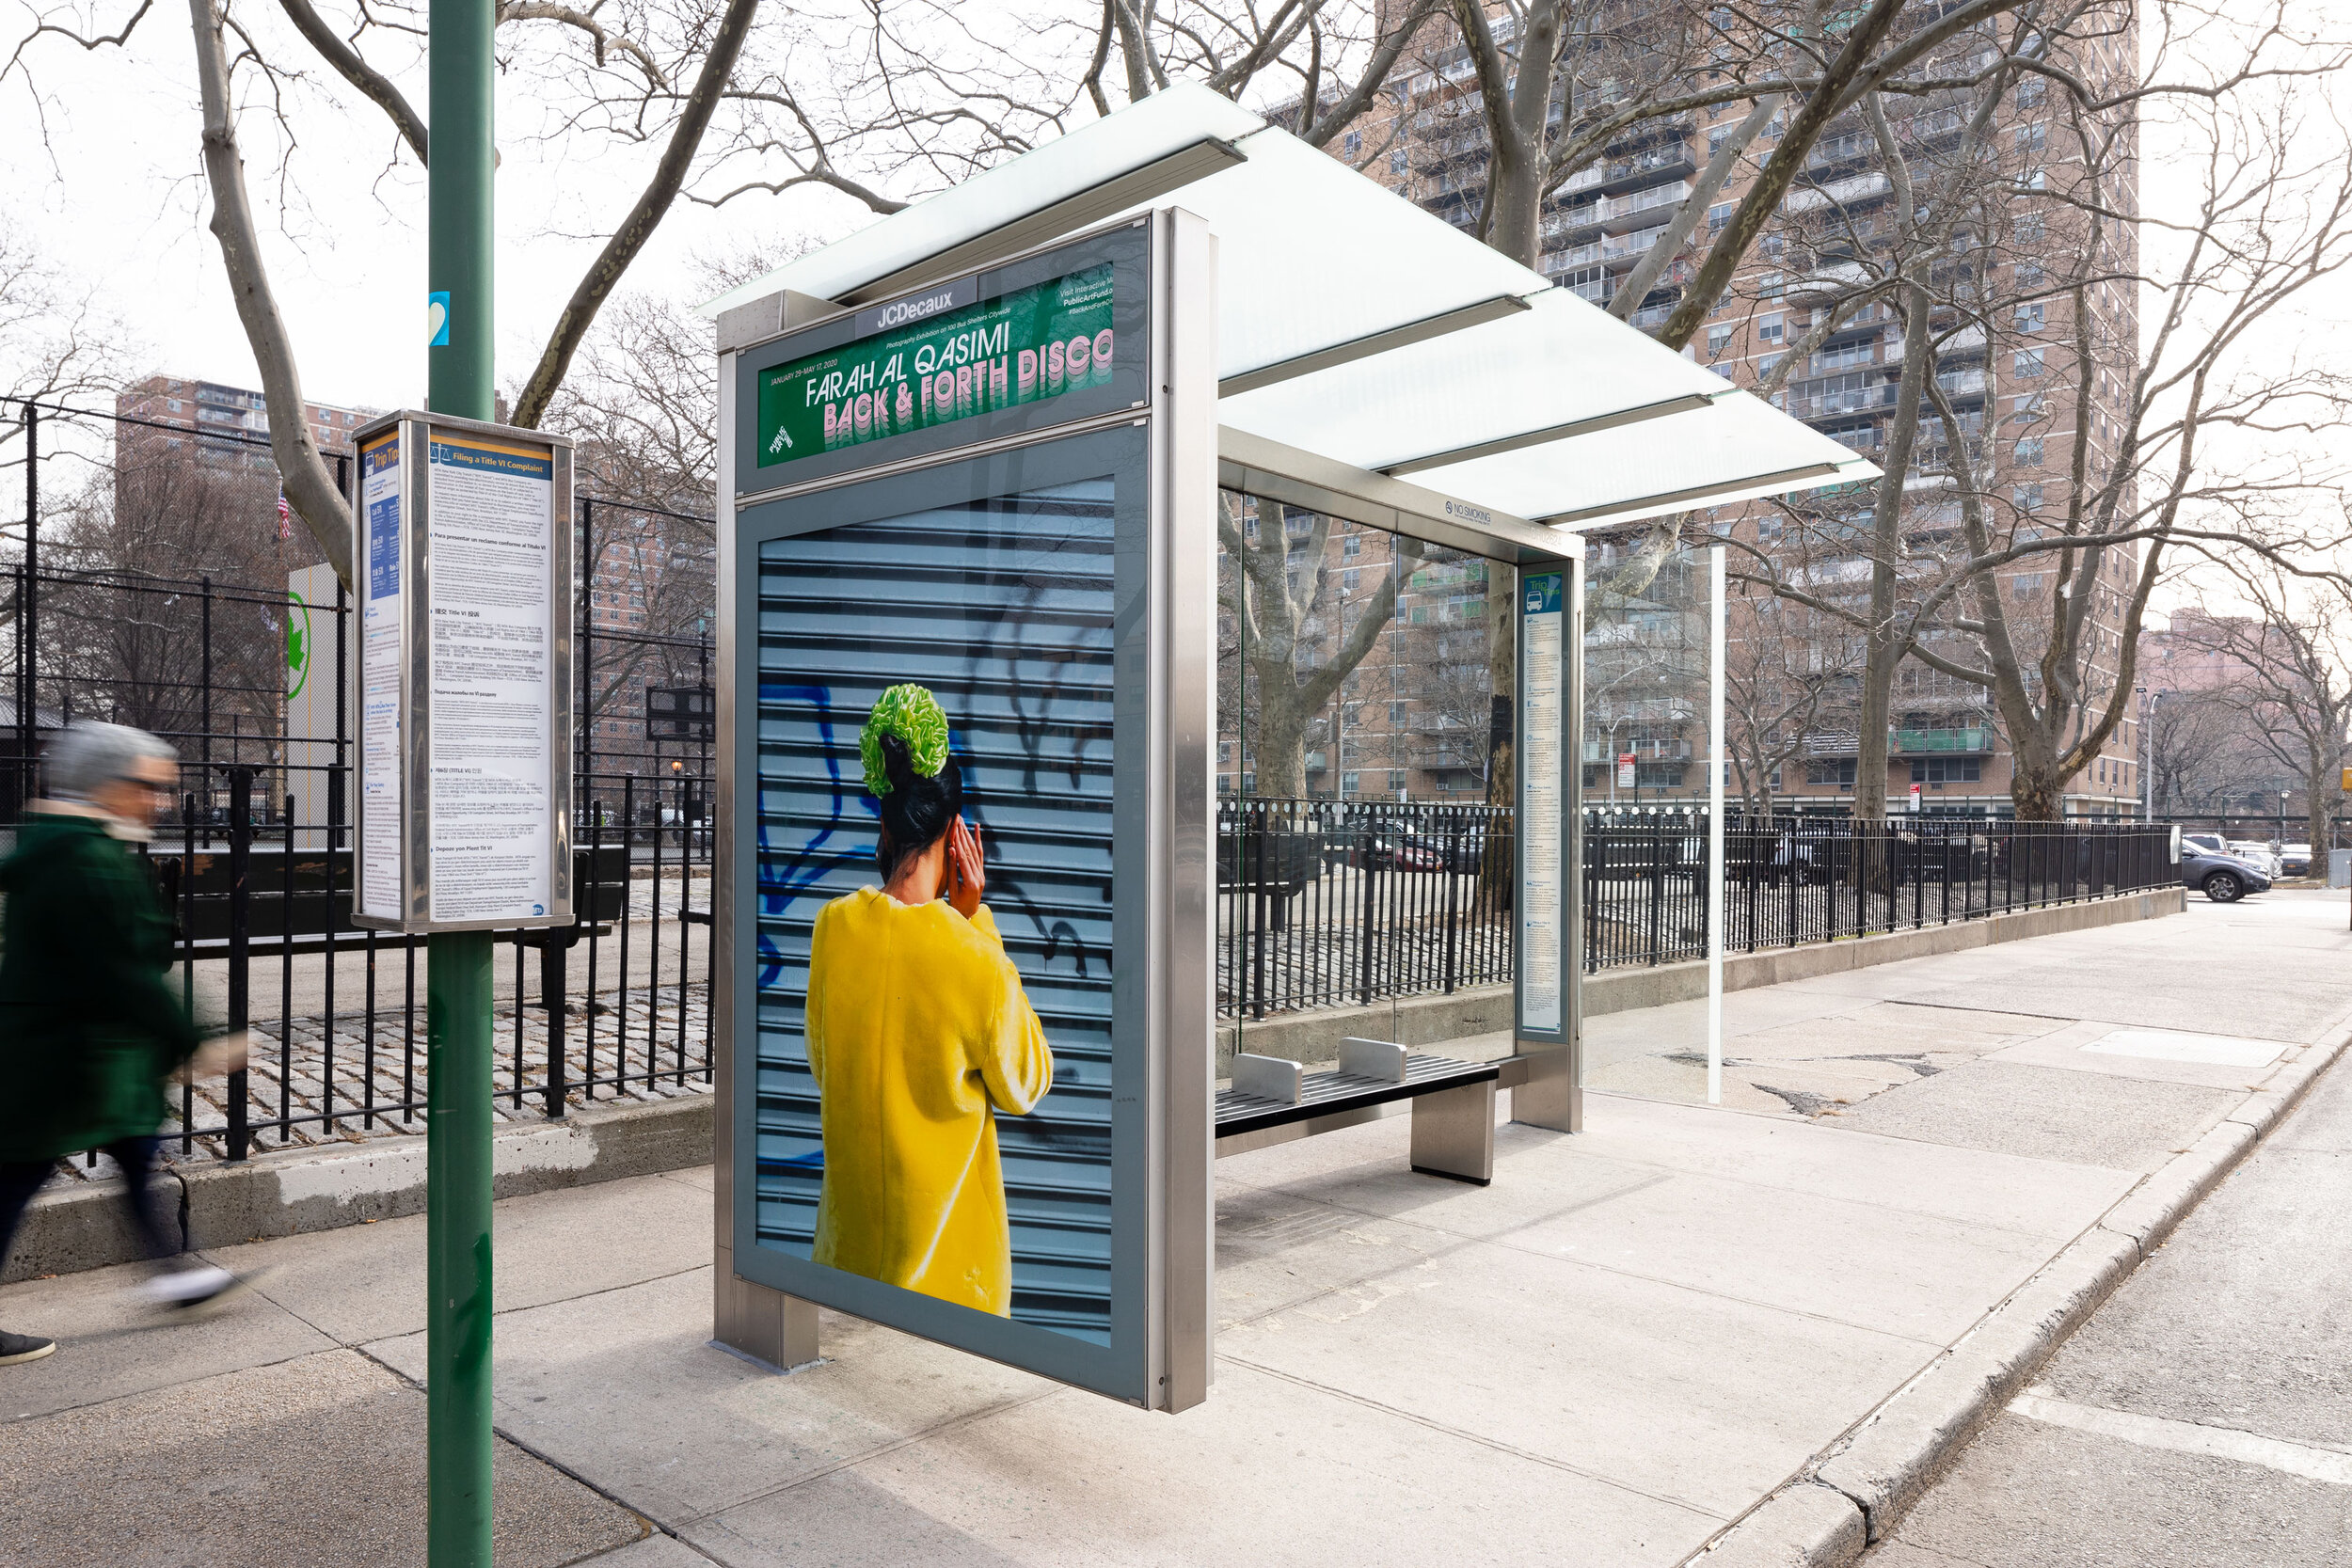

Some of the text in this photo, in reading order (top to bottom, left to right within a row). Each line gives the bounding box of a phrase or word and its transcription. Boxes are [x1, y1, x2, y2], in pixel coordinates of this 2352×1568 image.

[1060, 287, 1073, 297] Visit
[1074, 278, 1106, 294] Interactive
[877, 292, 953, 328] JCDecaux
[886, 335, 915, 350] Photography
[916, 329, 940, 341] Exhibition
[947, 323, 956, 332] 100
[957, 321, 966, 329] Bus
[967, 314, 988, 326] Shelters
[988, 307, 1011, 320] Citywide
[771, 372, 794, 387] JANUARY
[823, 358, 838, 369] 2020
[806, 321, 1010, 407] FARAH AL QASIMI
[824, 328, 1113, 434] BACK & FORTH DISCO
[374, 451, 388, 468] Trip
[453, 451, 473, 464] Filing
[481, 456, 497, 466] Title
[498, 459, 506, 467] VI
[507, 461, 543, 473] Complaint
[1454, 503, 1464, 515] NO
[1464, 506, 1491, 522] SMOKING
[478, 537, 498, 546] reclamo
[1530, 579, 1560, 597] Trip Tips
